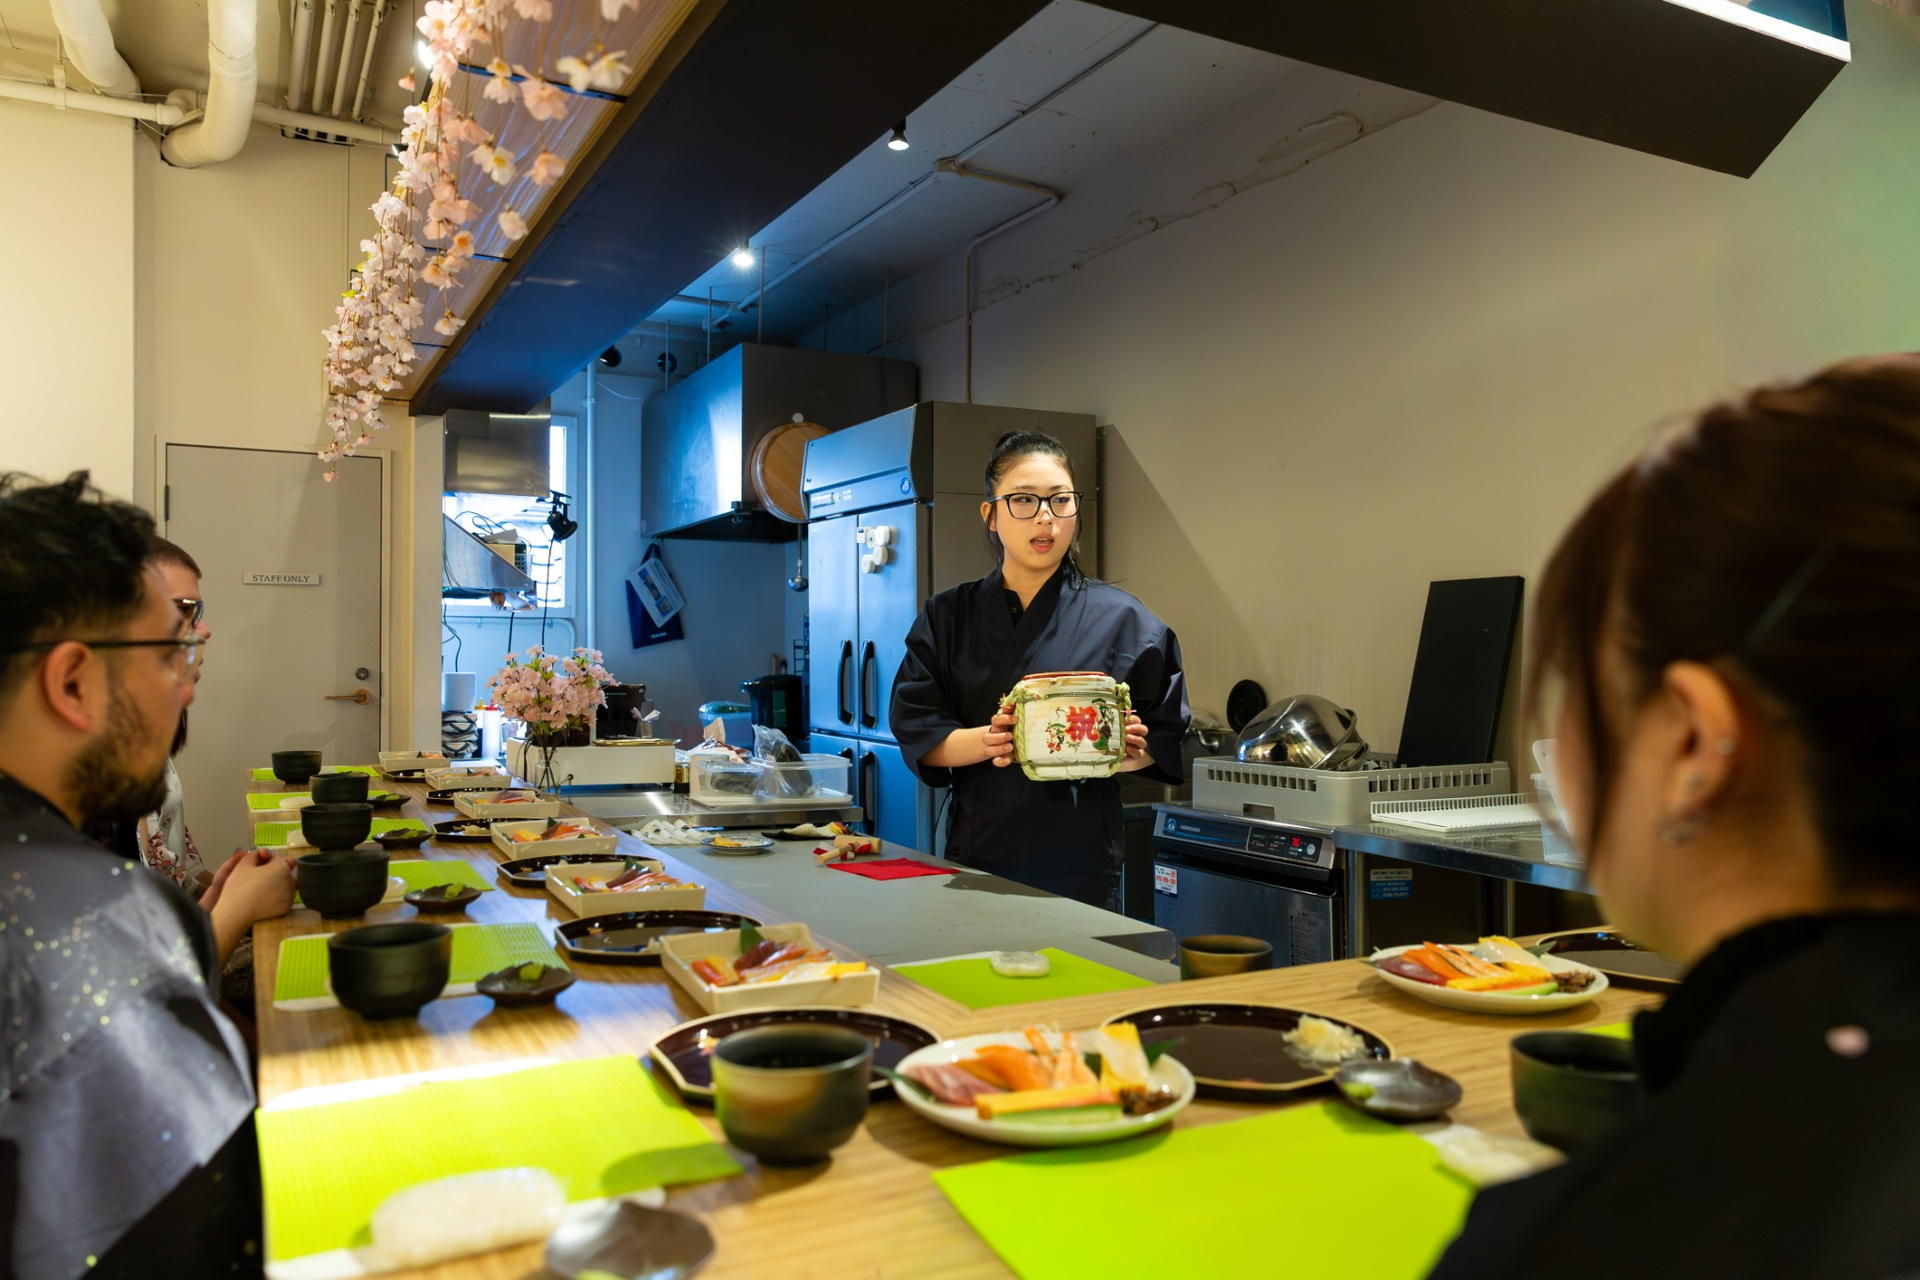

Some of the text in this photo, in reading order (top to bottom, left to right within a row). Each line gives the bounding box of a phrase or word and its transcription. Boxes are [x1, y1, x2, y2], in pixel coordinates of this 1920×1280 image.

[252, 574, 310, 583] STAFF ONLY
[1065, 706, 1099, 742] 祝
